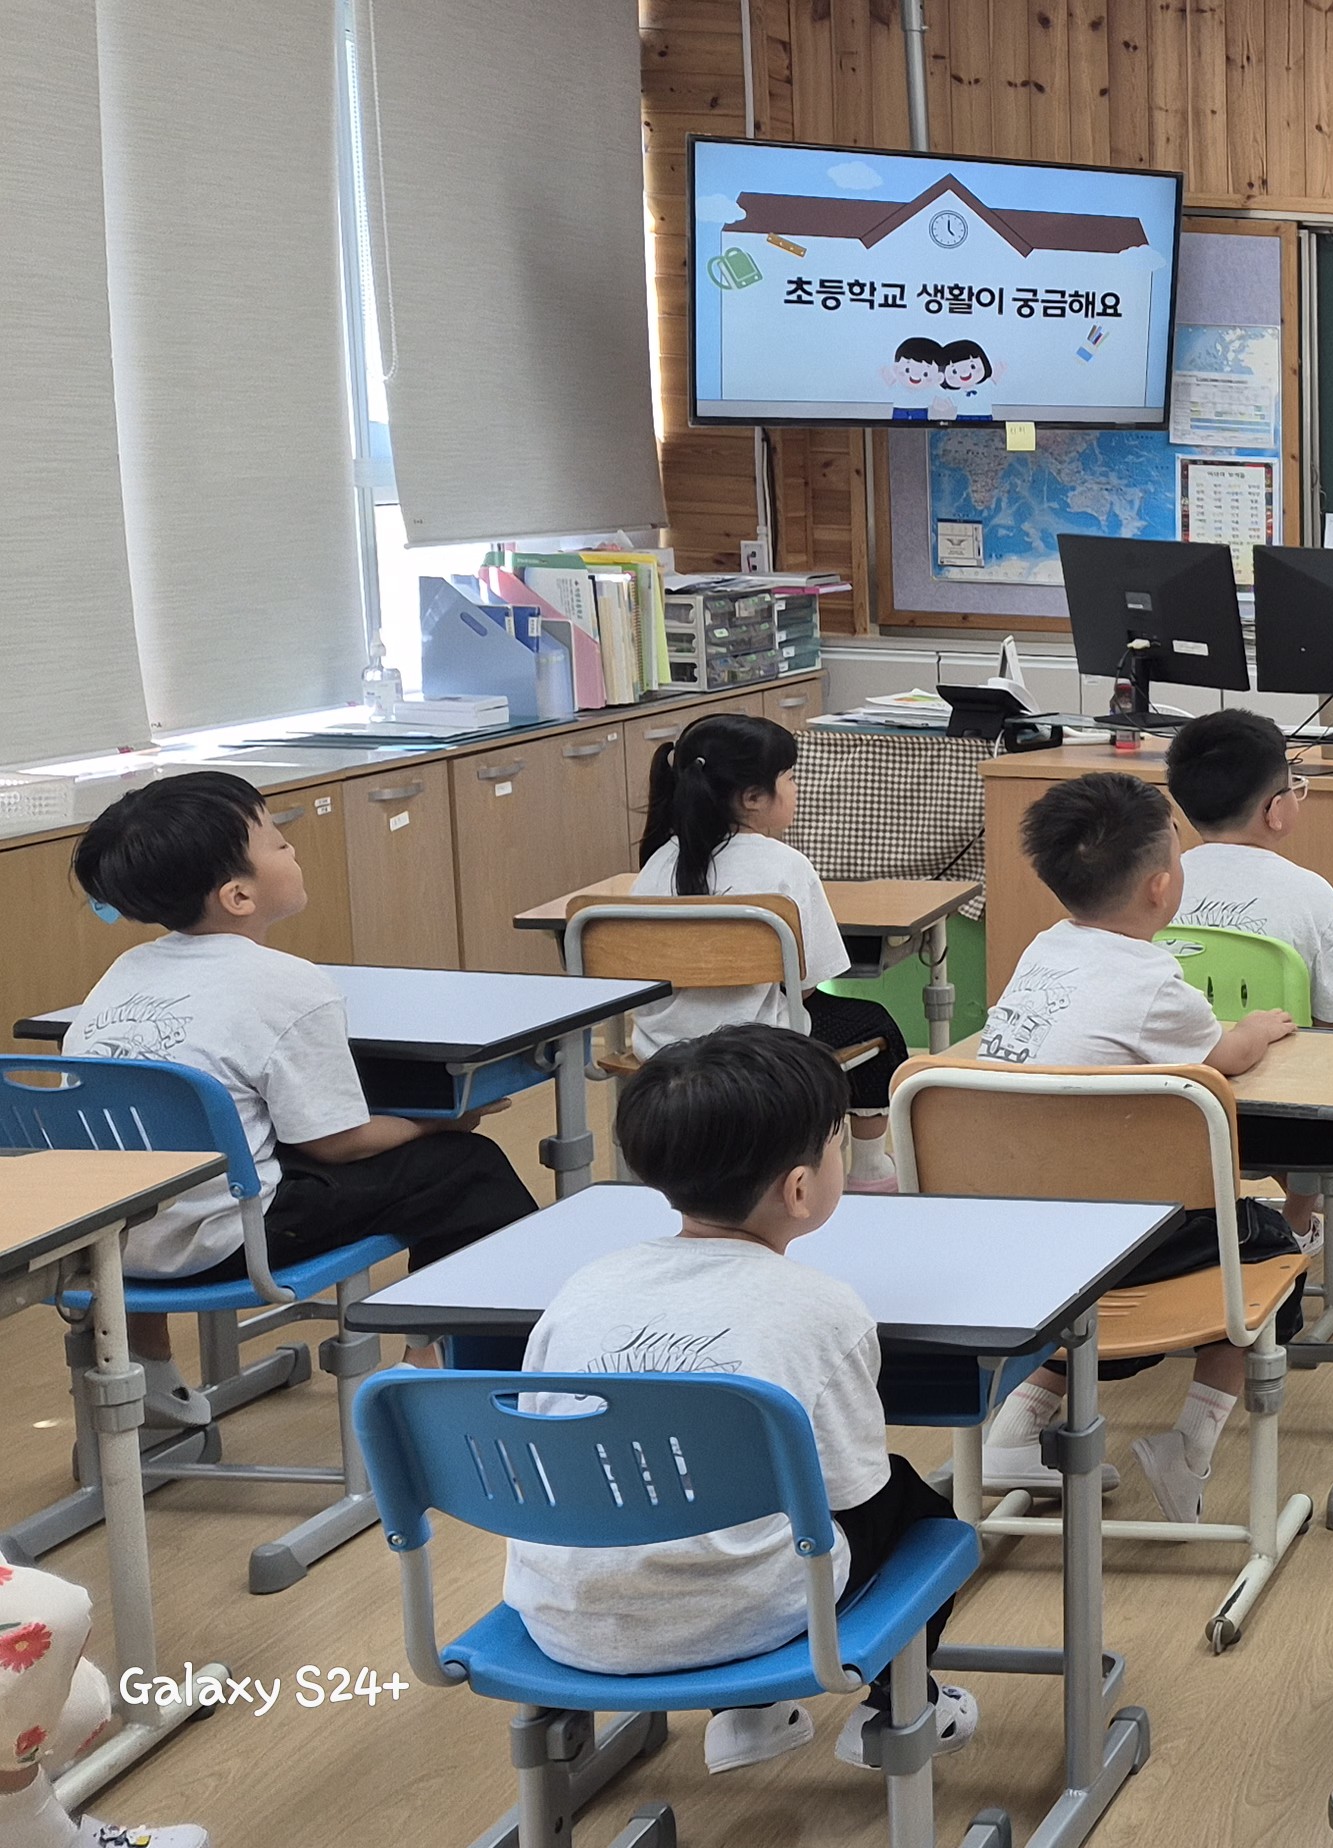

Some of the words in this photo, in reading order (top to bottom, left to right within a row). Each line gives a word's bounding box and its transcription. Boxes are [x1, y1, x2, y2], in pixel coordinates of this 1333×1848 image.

[783, 276, 907, 311] 초등학교
[916, 283, 1004, 315] 생활이
[1011, 287, 1122, 319] 궁금해요
